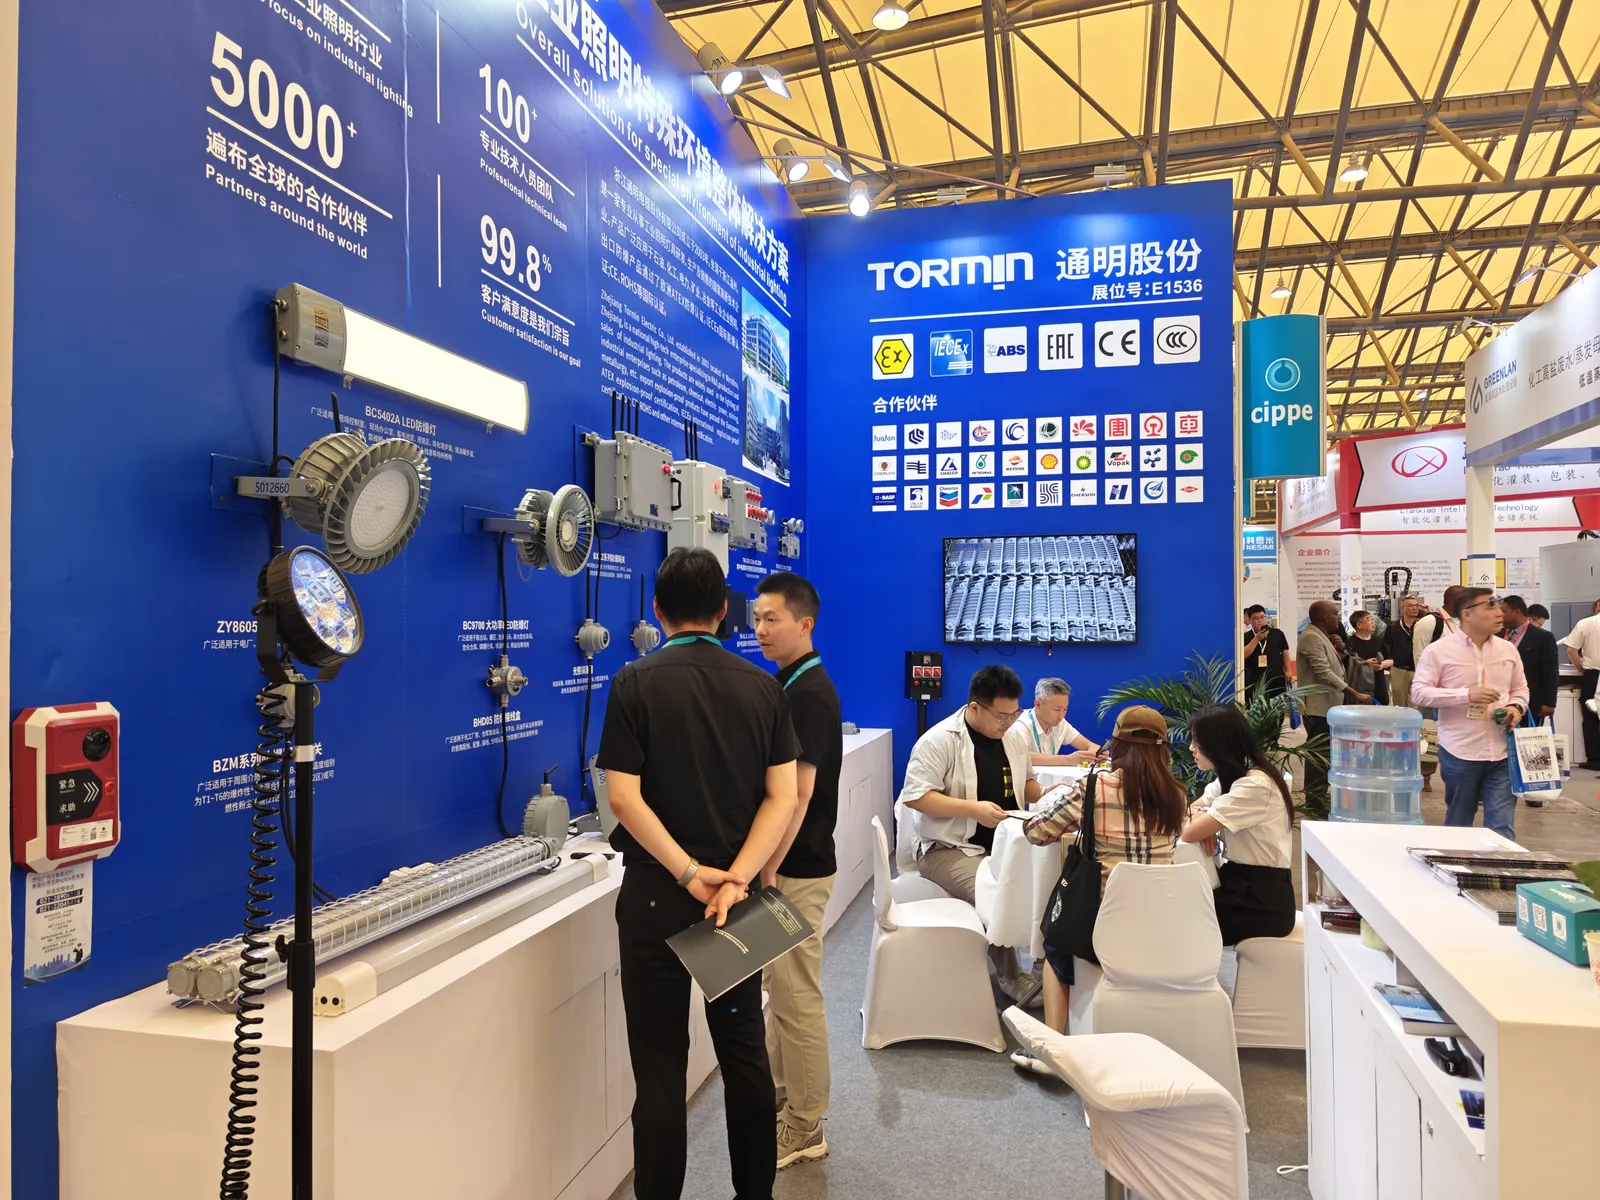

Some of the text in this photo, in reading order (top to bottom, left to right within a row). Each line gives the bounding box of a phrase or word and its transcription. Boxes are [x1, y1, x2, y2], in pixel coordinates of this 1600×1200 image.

[294, 0, 383, 70] 业照明行业
[306, 26, 321, 45] on
[323, 36, 375, 87] industrial
[376, 77, 413, 118] lighting
[516, 0, 570, 77] Overall
[573, 68, 625, 135] solution
[627, 121, 643, 153] for
[644, 144, 679, 190] special
[729, 236, 738, 249] of
[536, 0, 789, 284] 业照明特殊环境整体解决方案
[206, 127, 368, 237] 遍布全球的合作伙伴
[480, 130, 554, 203] 专业技术人员团队
[205, 163, 368, 260] Partners around the world
[480, 158, 568, 233] Professional technical team
[480, 214, 552, 292] 99.8%
[868, 238, 1203, 291] TORMIN 通明股份
[481, 283, 570, 347] 客户满意度是我们宗旨
[481, 308, 581, 368] Customer satisfaction is our goal
[934, 338, 969, 357] IECEx
[996, 344, 1026, 357] ABS
[1098, 329, 1136, 356] CE
[1483, 359, 1517, 389] GREENLAN
[365, 405, 437, 436] BC5402A LED防爆灯
[872, 394, 938, 413] 合作伙伴
[1251, 400, 1313, 427] cippe
[255, 482, 290, 494] 5012660
[1494, 504, 1539, 512] Technology
[1297, 548, 1331, 557] 企业简介
[463, 620, 486, 630] BC9700
